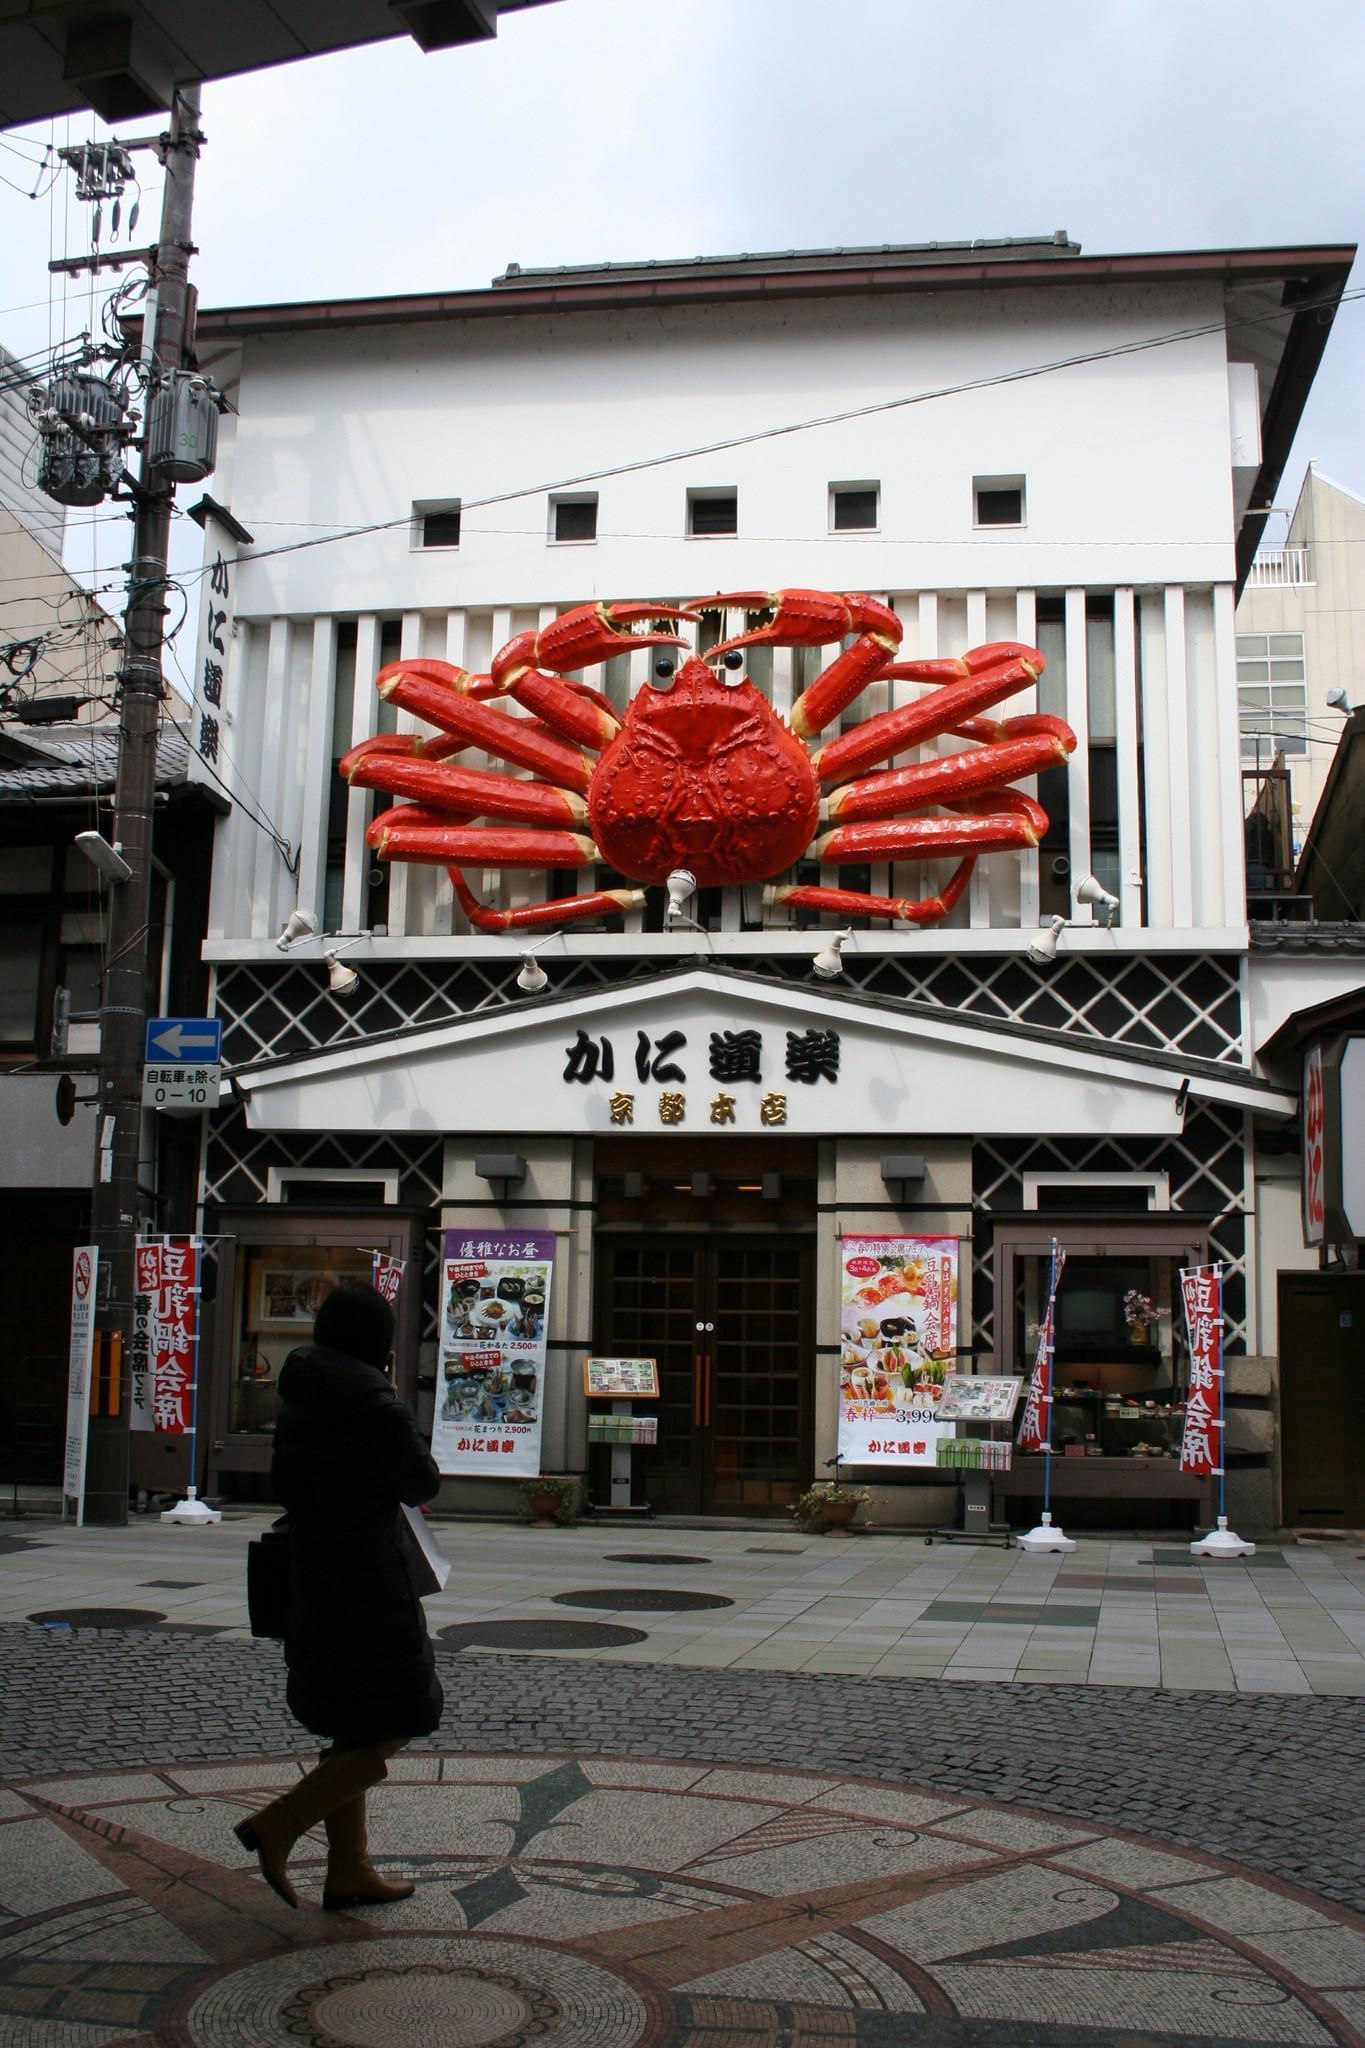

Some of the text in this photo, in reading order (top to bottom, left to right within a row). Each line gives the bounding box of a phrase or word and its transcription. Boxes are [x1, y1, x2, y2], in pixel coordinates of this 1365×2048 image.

[563, 1029, 840, 1084] かに道楽
[147, 1070, 216, 1084] 自転車を除く
[608, 1090, 788, 1125] 京都本店
[460, 1241, 539, 1258] 優雅なお昼
[923, 1257, 940, 1353] 豆乳鍋会席
